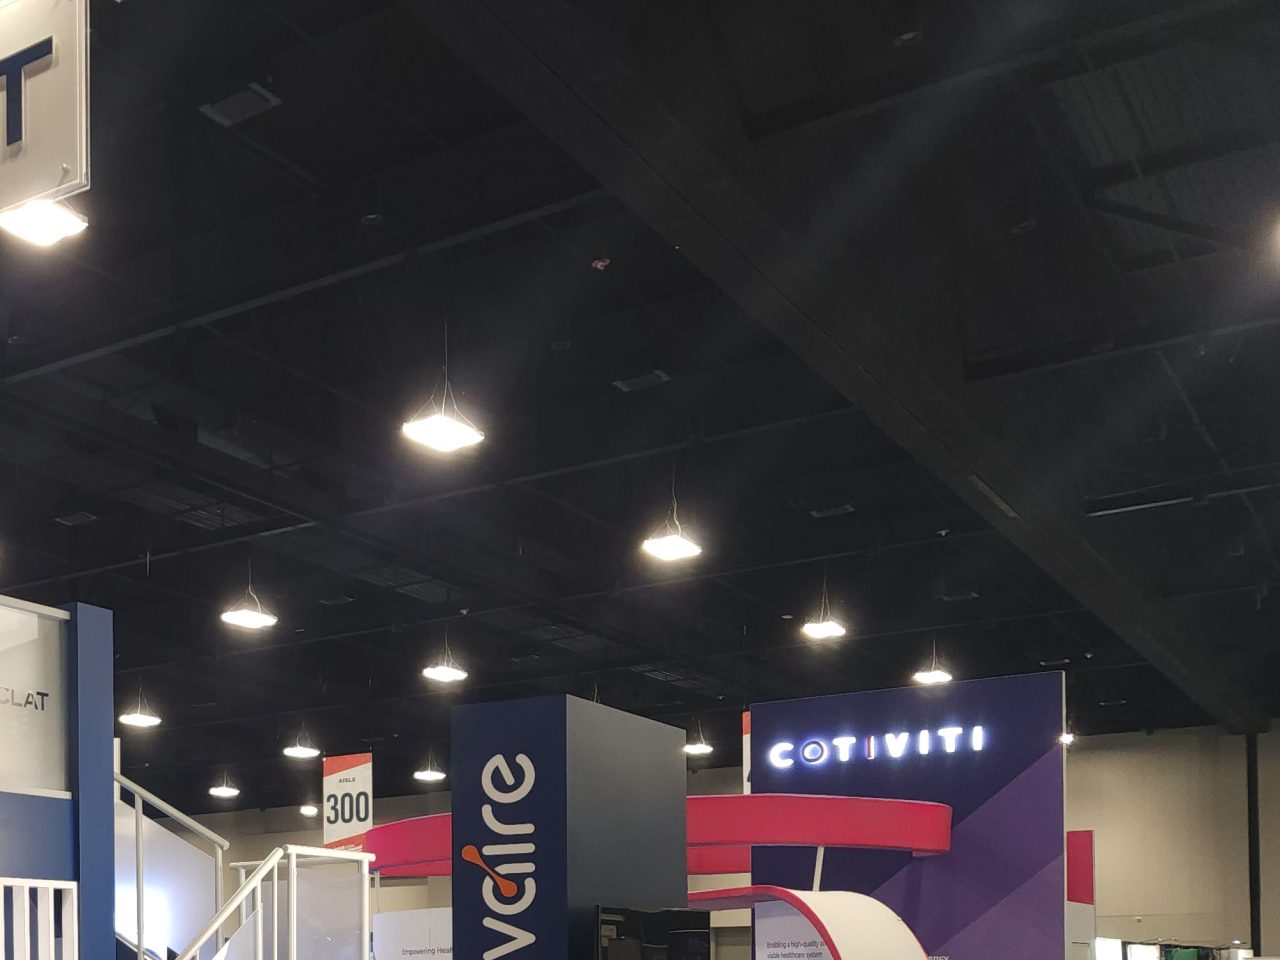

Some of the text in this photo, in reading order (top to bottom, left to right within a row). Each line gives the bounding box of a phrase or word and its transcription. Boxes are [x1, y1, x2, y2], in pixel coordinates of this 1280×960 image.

[769, 724, 984, 769] COTIVITI
[338, 776, 357, 784] AISLE
[326, 790, 370, 825] 300
[767, 941, 787, 949] Enabling
[790, 940, 819, 949] high-quality
[402, 947, 436, 956] Empowering
[780, 951, 805, 959] healthcare
[806, 951, 823, 960] system
